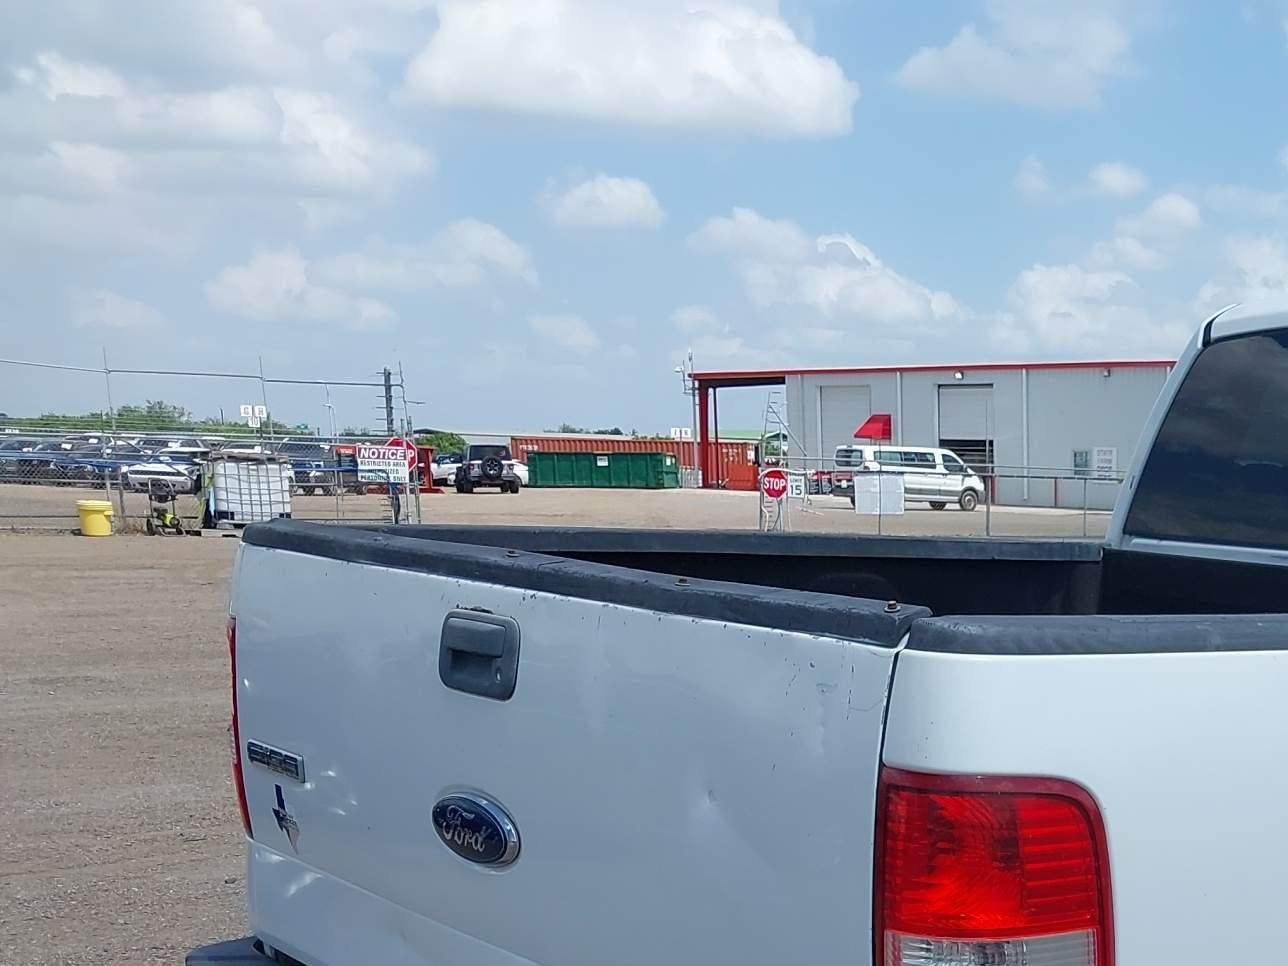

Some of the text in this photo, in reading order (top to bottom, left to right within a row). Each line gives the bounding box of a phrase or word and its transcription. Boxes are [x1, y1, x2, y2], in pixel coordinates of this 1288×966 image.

[360, 447, 405, 460] NOTICE
[764, 477, 786, 491] STOP
[790, 485, 802, 496] 15
[442, 804, 493, 852] Ford
